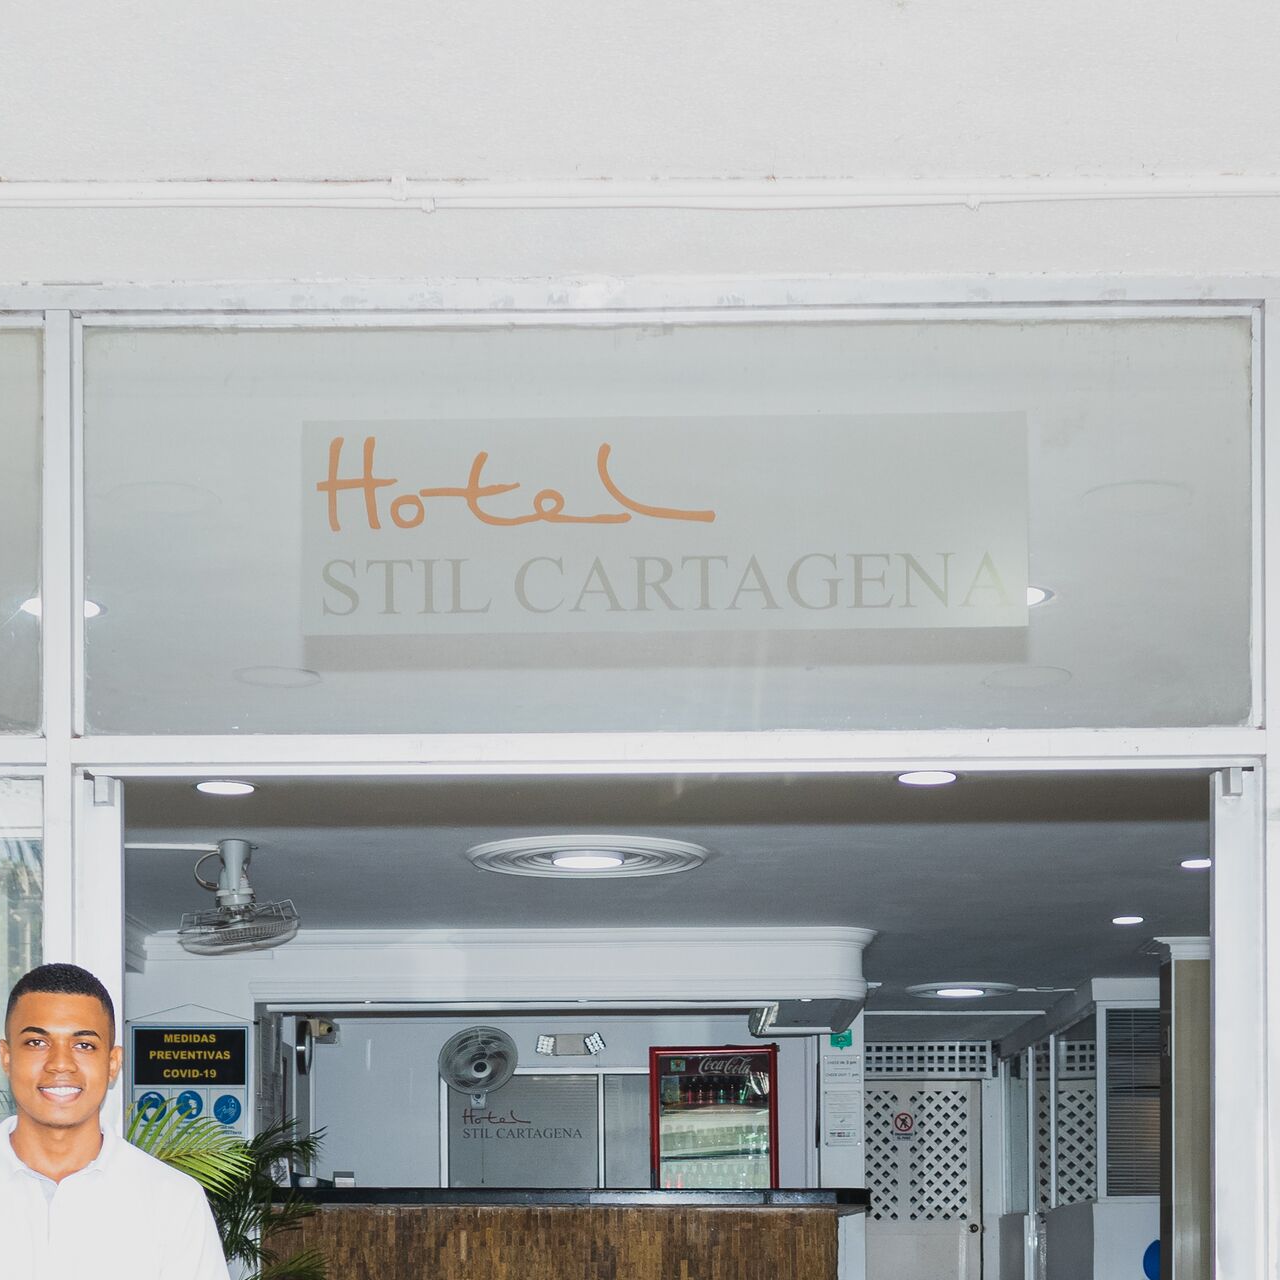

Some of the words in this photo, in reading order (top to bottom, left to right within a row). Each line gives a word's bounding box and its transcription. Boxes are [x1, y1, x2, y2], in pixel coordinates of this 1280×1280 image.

[317, 437, 715, 532] Hotel
[321, 557, 492, 617] STIL
[515, 549, 1017, 614] CARTAGENA
[163, 1034, 217, 1043] MEDIDAS
[149, 1050, 231, 1060] PREVENTIVAS
[163, 1069, 217, 1078] COVID-19
[462, 1108, 531, 1125] Hotel
[462, 1127, 493, 1139] STIL
[496, 1126, 583, 1139] CARTAGENA
